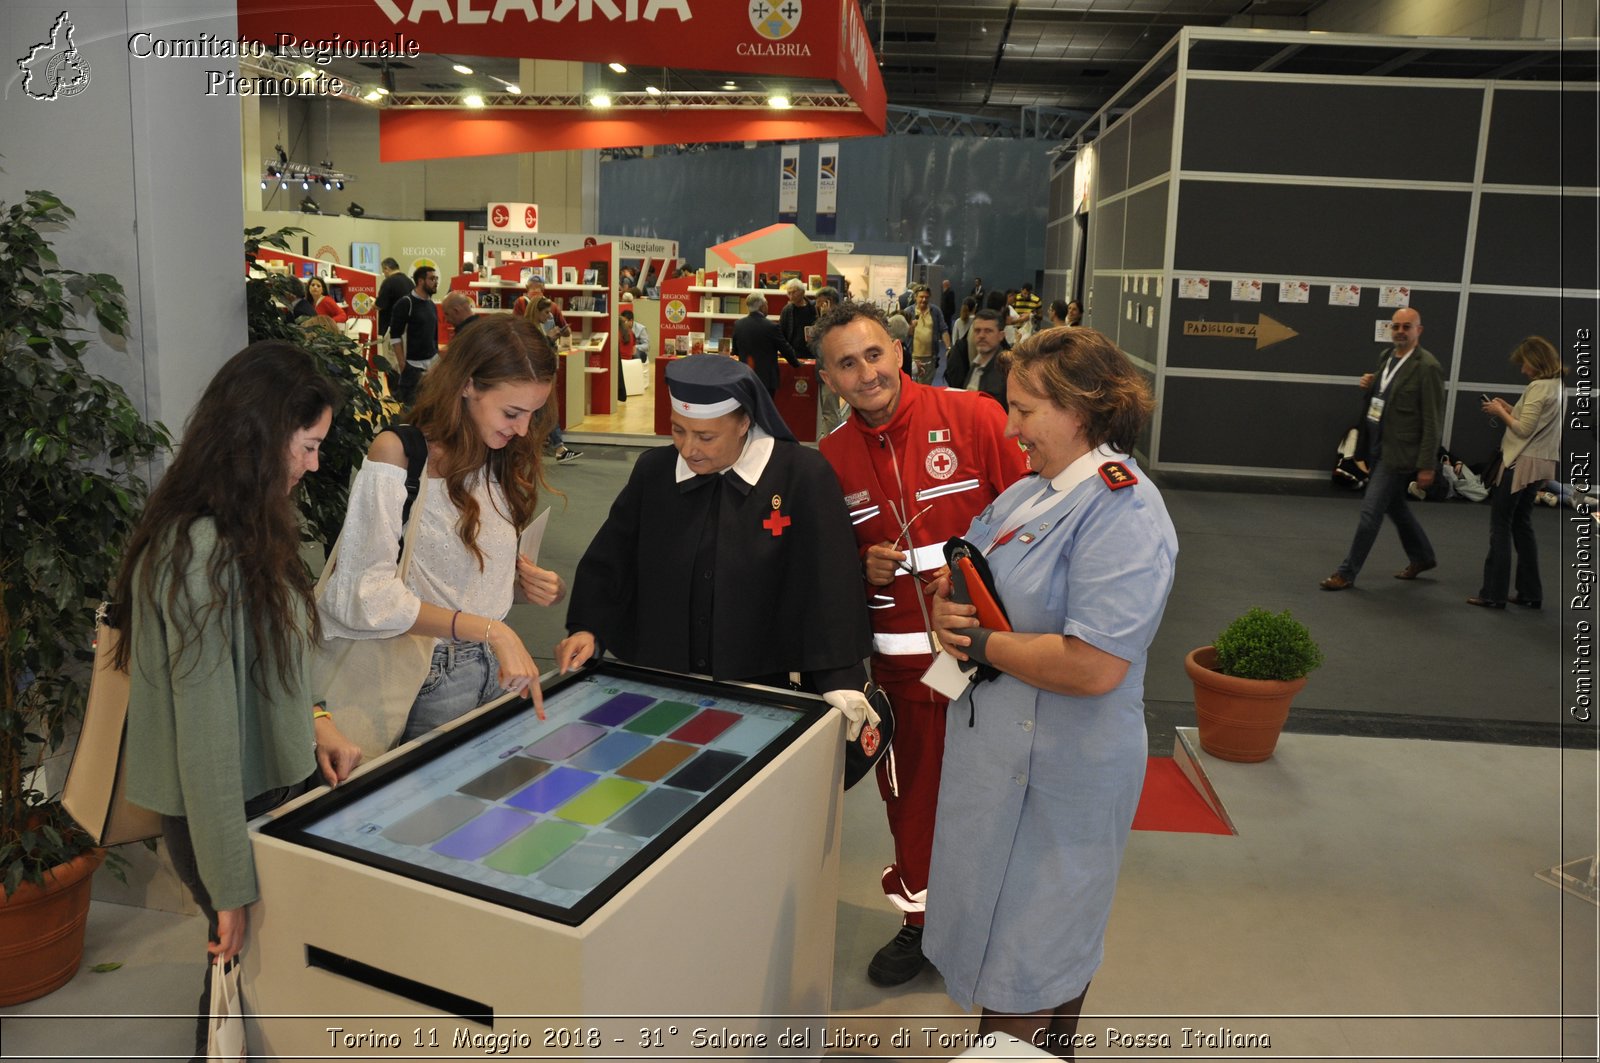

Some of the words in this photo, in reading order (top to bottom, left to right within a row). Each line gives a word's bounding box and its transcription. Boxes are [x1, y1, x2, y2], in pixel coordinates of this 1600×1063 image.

[736, 42, 811, 56] CALABRIA
[402, 247, 446, 256] REGIONE
[1247, 325, 1257, 336] 4
